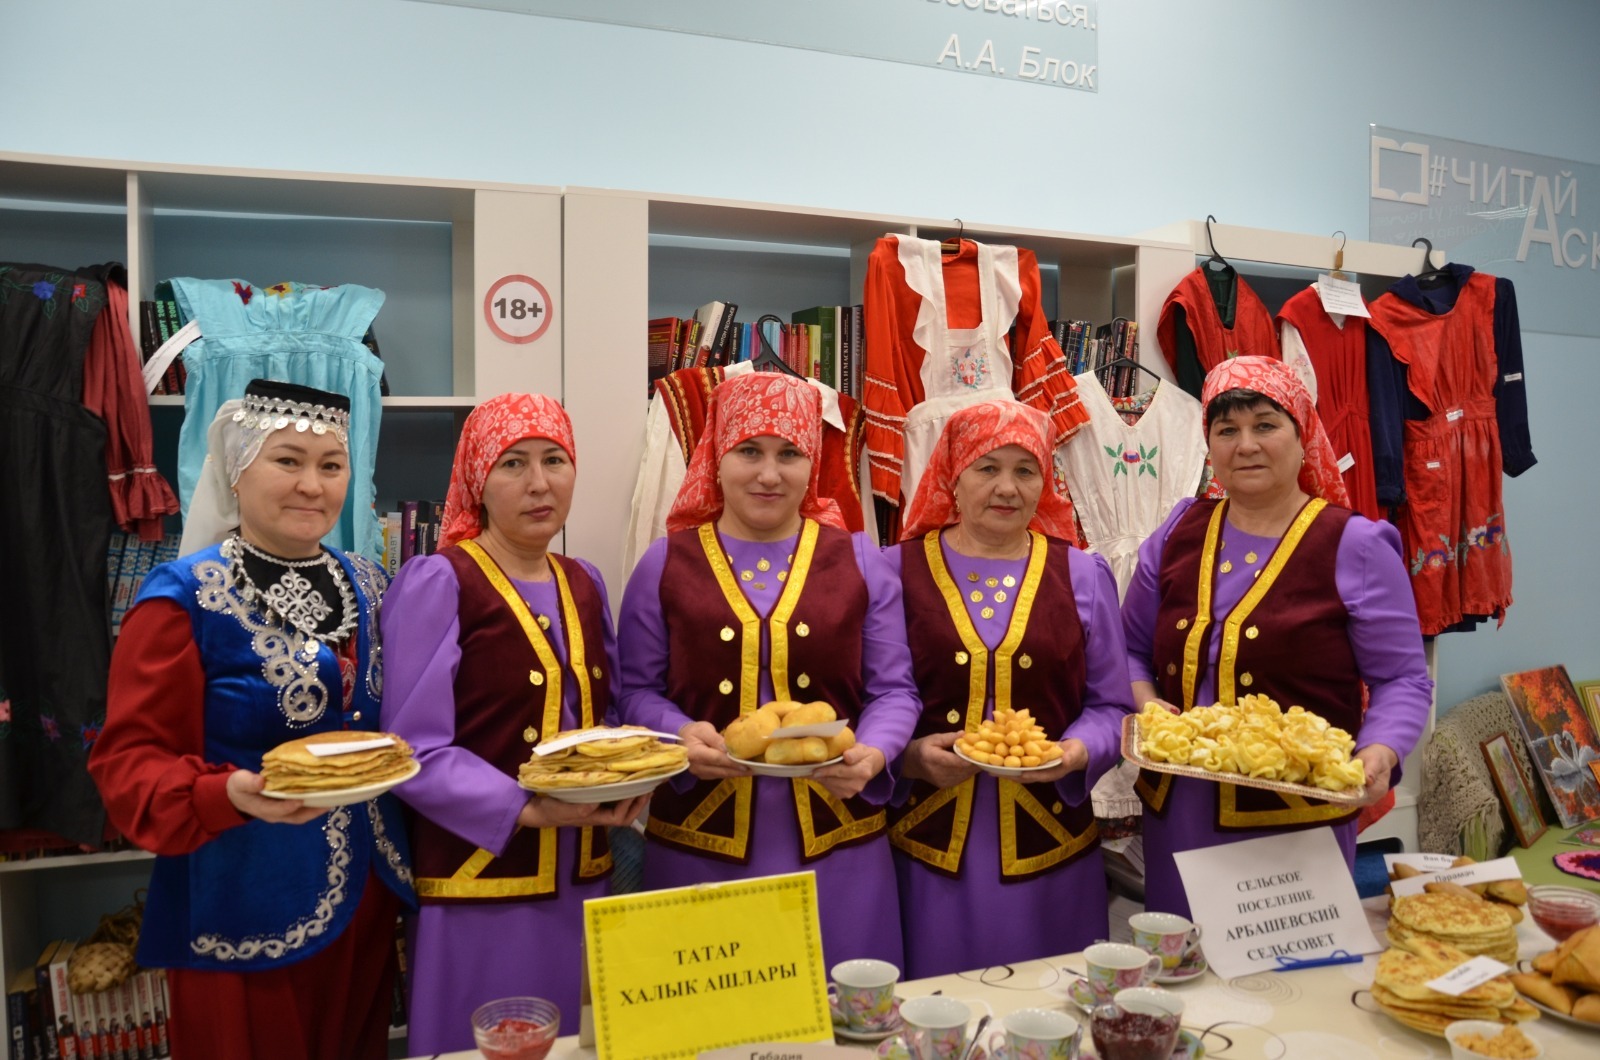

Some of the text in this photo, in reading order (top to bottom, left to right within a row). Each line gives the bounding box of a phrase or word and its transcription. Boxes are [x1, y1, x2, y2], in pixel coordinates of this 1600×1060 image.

[1018, 45, 1097, 88] Блок
[494, 298, 543, 320] 18+
[719, 331, 729, 347] АНТОН
[1236, 871, 1303, 893] СЕЛЬСКОЕ
[1237, 889, 1316, 915] ПОСЕЛЕНИЕ
[1225, 904, 1341, 942] АРБАШЕВСКИЙ
[673, 941, 741, 966] ТАТАР
[1246, 933, 1336, 962] СЕЛЬСОВЕТ
[619, 962, 798, 1007] ХАЛЫК АШЛАРЫ
